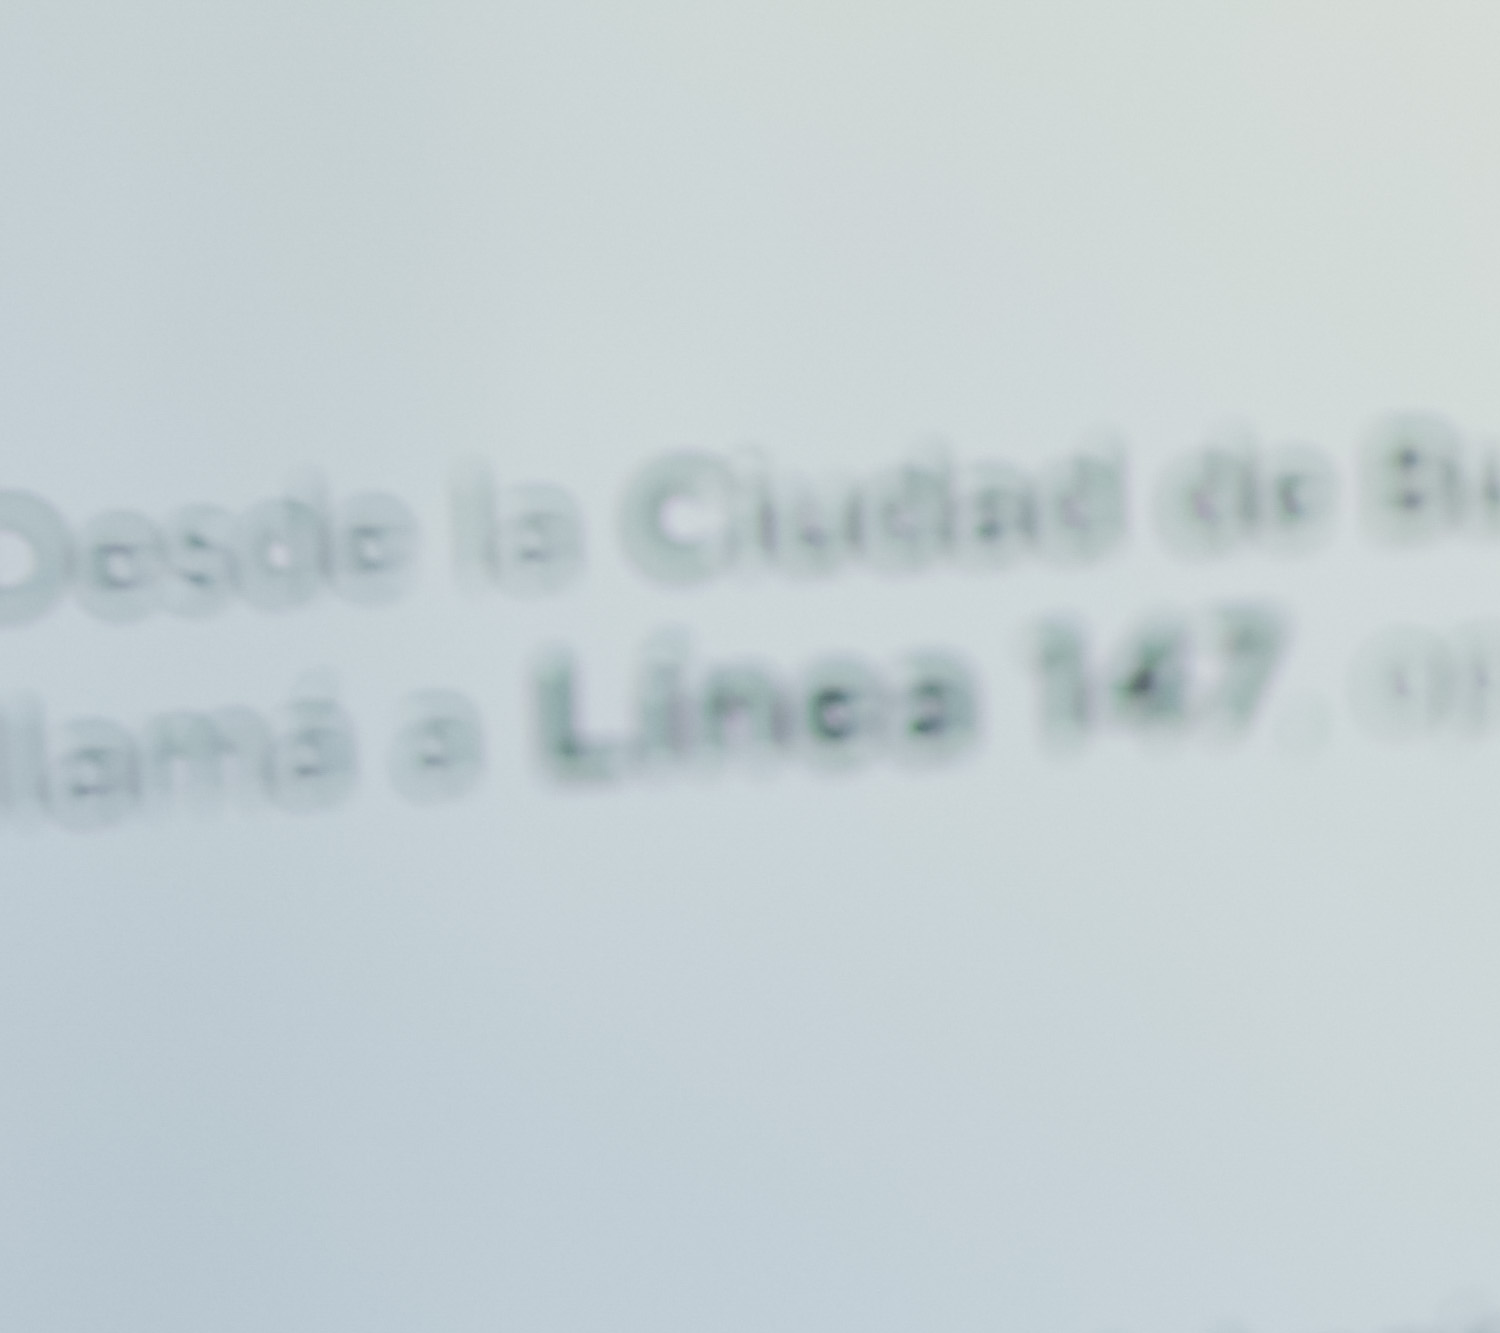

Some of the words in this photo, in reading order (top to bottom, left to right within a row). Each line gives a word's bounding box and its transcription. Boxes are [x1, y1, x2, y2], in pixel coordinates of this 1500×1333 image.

[454, 463, 579, 593] la
[620, 433, 1125, 583] Ciudad
[1159, 404, 1335, 555] de
[390, 692, 482, 800] a
[527, 627, 973, 788] Línea
